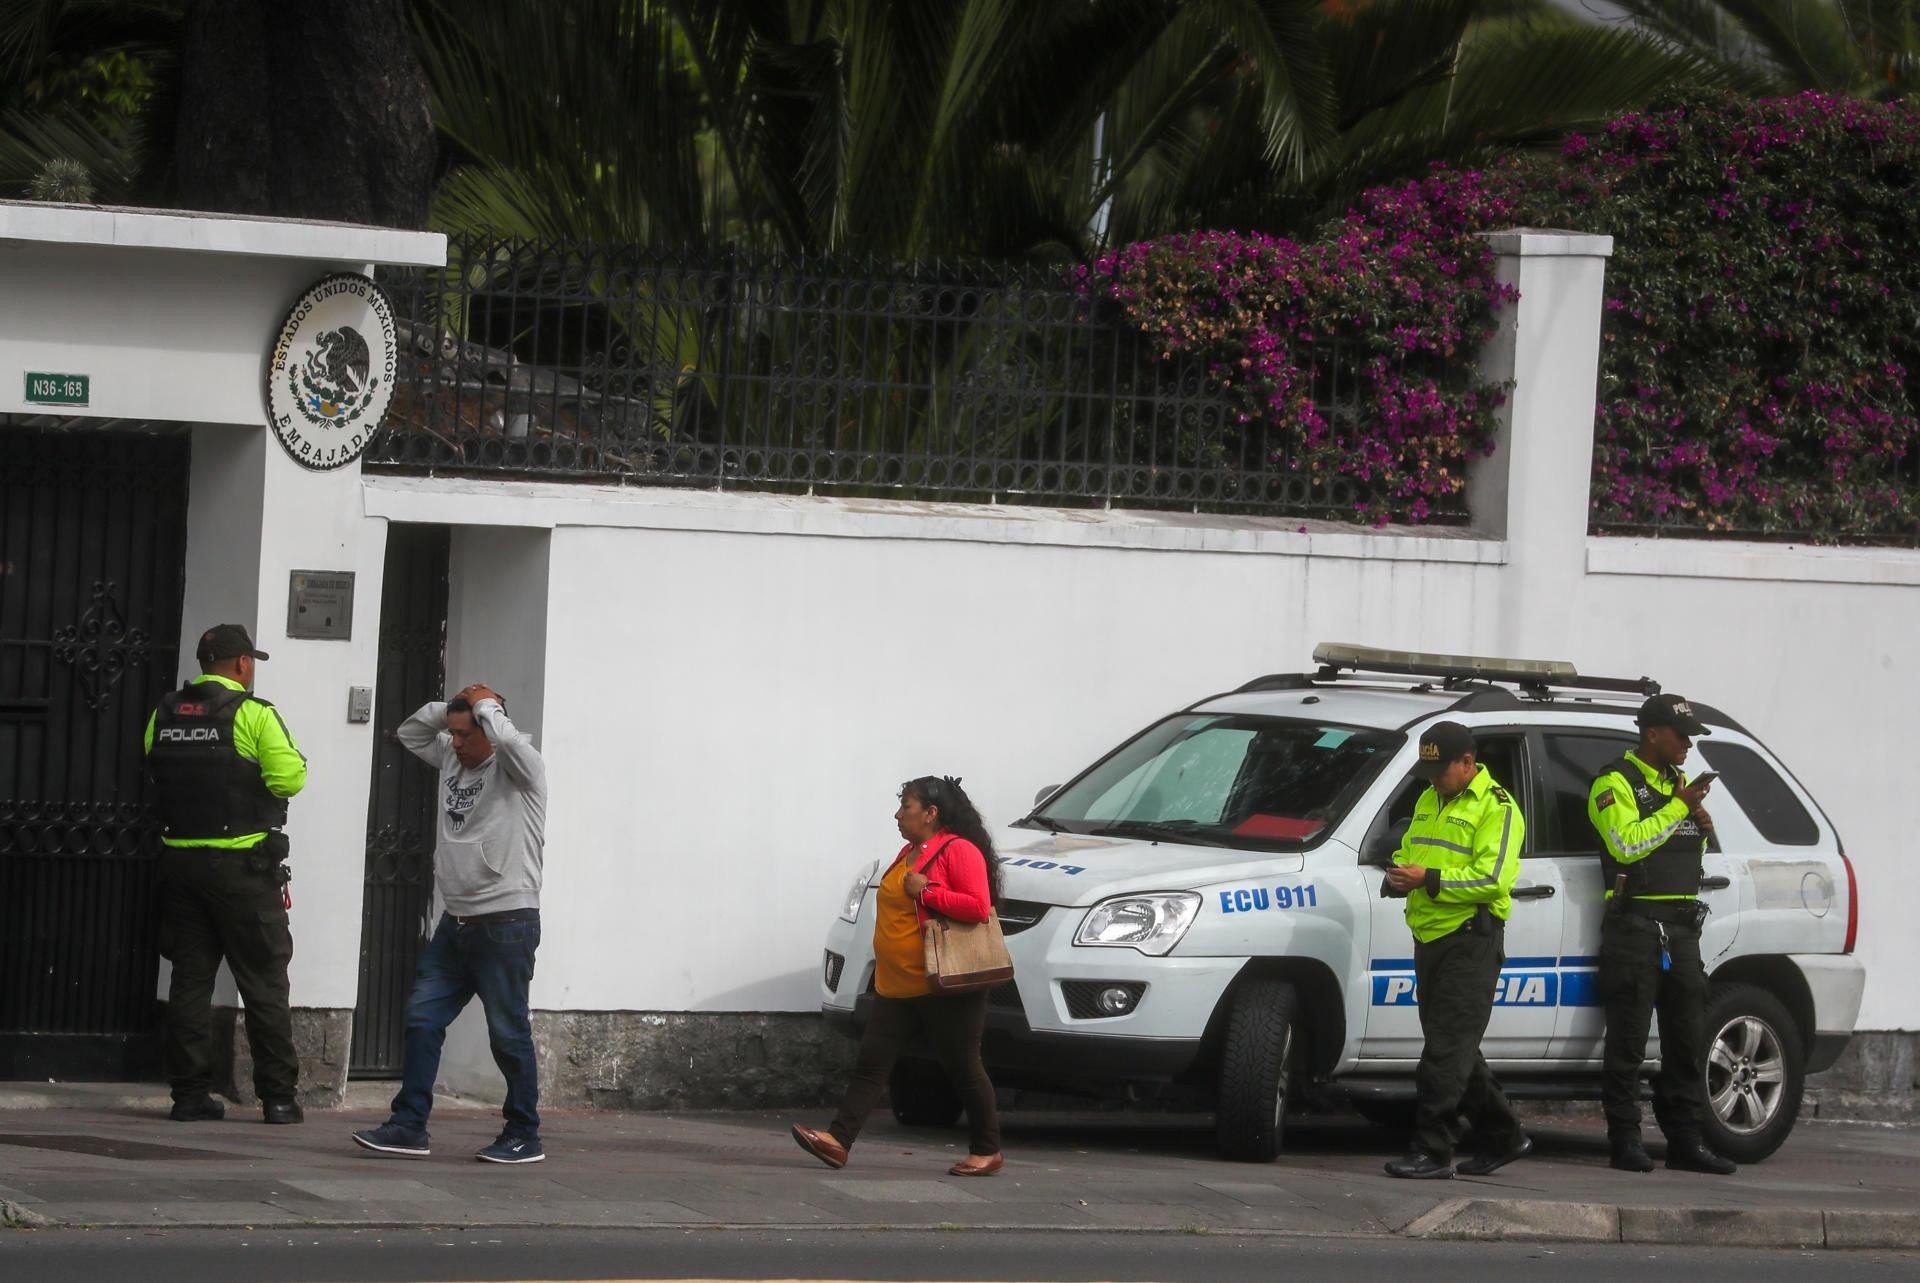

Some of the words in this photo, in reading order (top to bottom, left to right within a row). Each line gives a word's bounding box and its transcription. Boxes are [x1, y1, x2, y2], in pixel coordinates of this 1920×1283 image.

[275, 303, 313, 371] ESTADOS
[313, 282, 366, 304] UNIDOS
[367, 295, 394, 383] MEXICANOS
[279, 413, 374, 462] EMBAJADA
[159, 727, 220, 741] POLICIA
[1219, 888, 1270, 914] ECU
[1275, 884, 1317, 909] 911
